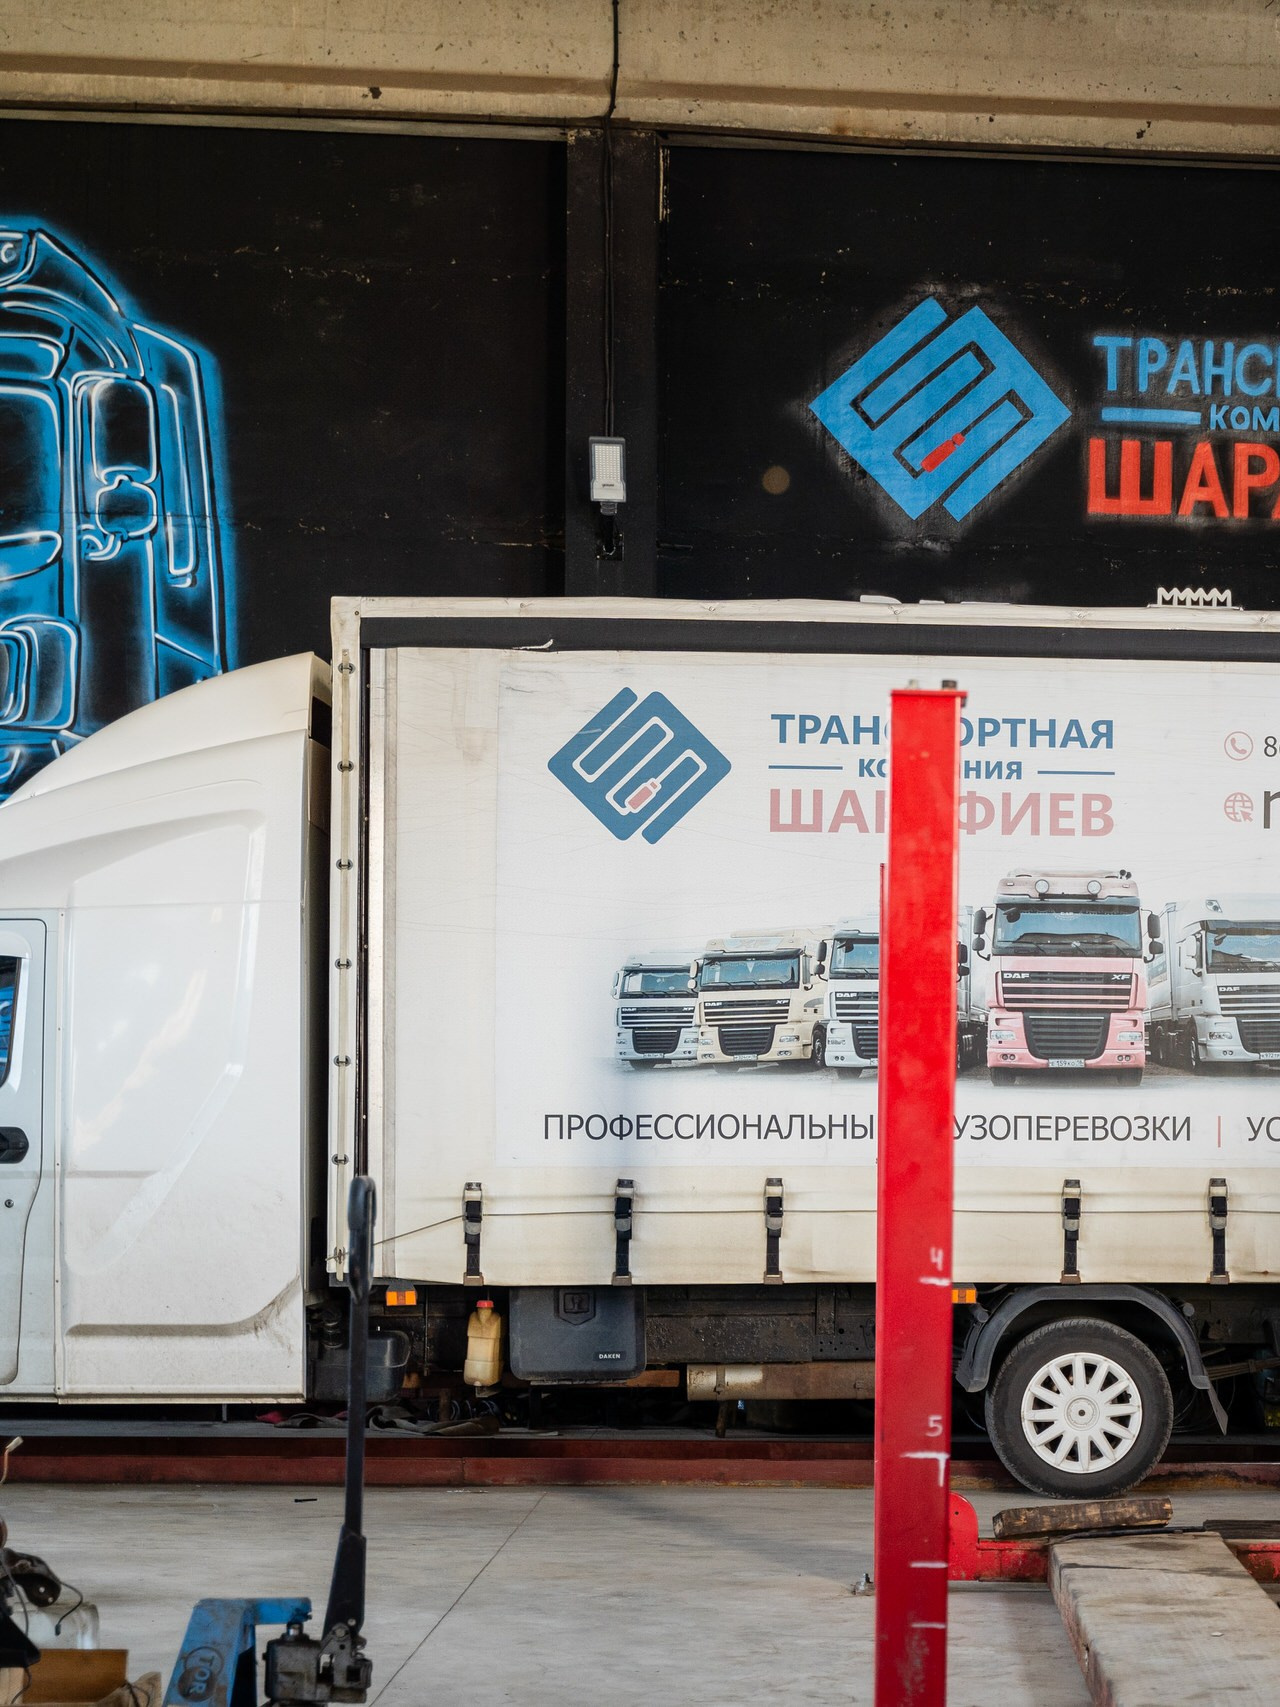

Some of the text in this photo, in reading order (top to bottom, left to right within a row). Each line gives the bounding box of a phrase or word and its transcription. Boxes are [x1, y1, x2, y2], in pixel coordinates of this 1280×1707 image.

[771, 713, 1114, 749] ТРАНРТНАЯ
[769, 788, 1115, 837] ШАФИЕВ
[543, 1113, 874, 1142] ПРОФЕССИОНАЛЬНЫ
[929, 1247, 943, 1271] 4
[925, 1414, 943, 1437] 5
[188, 1655, 215, 1694] TOR
